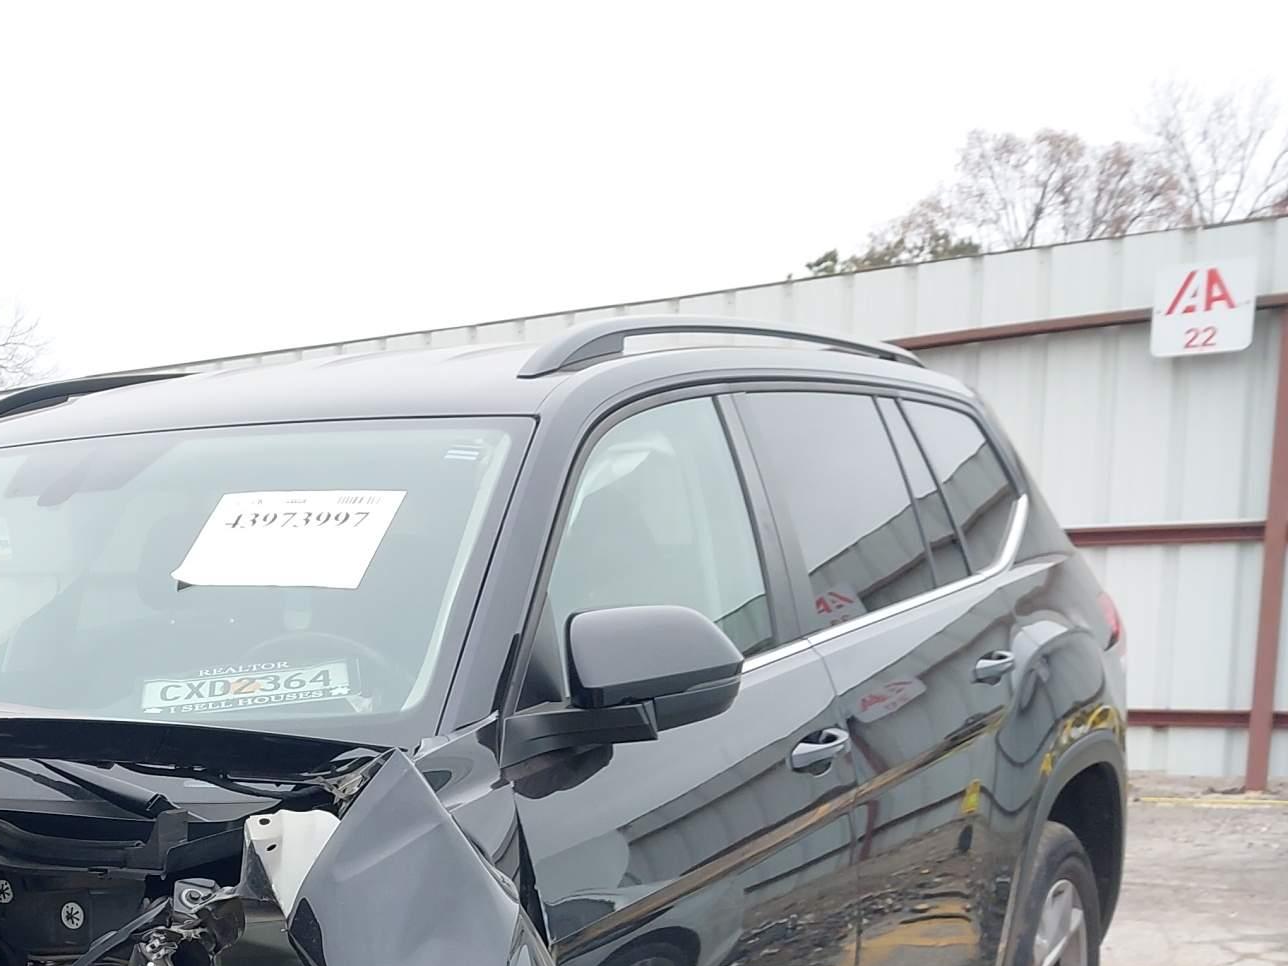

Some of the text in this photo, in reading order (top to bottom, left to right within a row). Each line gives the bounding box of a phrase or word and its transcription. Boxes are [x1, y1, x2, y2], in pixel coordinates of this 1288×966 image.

[1184, 326, 1218, 349] 22
[225, 511, 371, 529] 43973997
[198, 661, 290, 677] REALTOR
[159, 670, 332, 702] CXD2364
[180, 698, 233, 714] SELL
[237, 689, 324, 707] HOUSES
